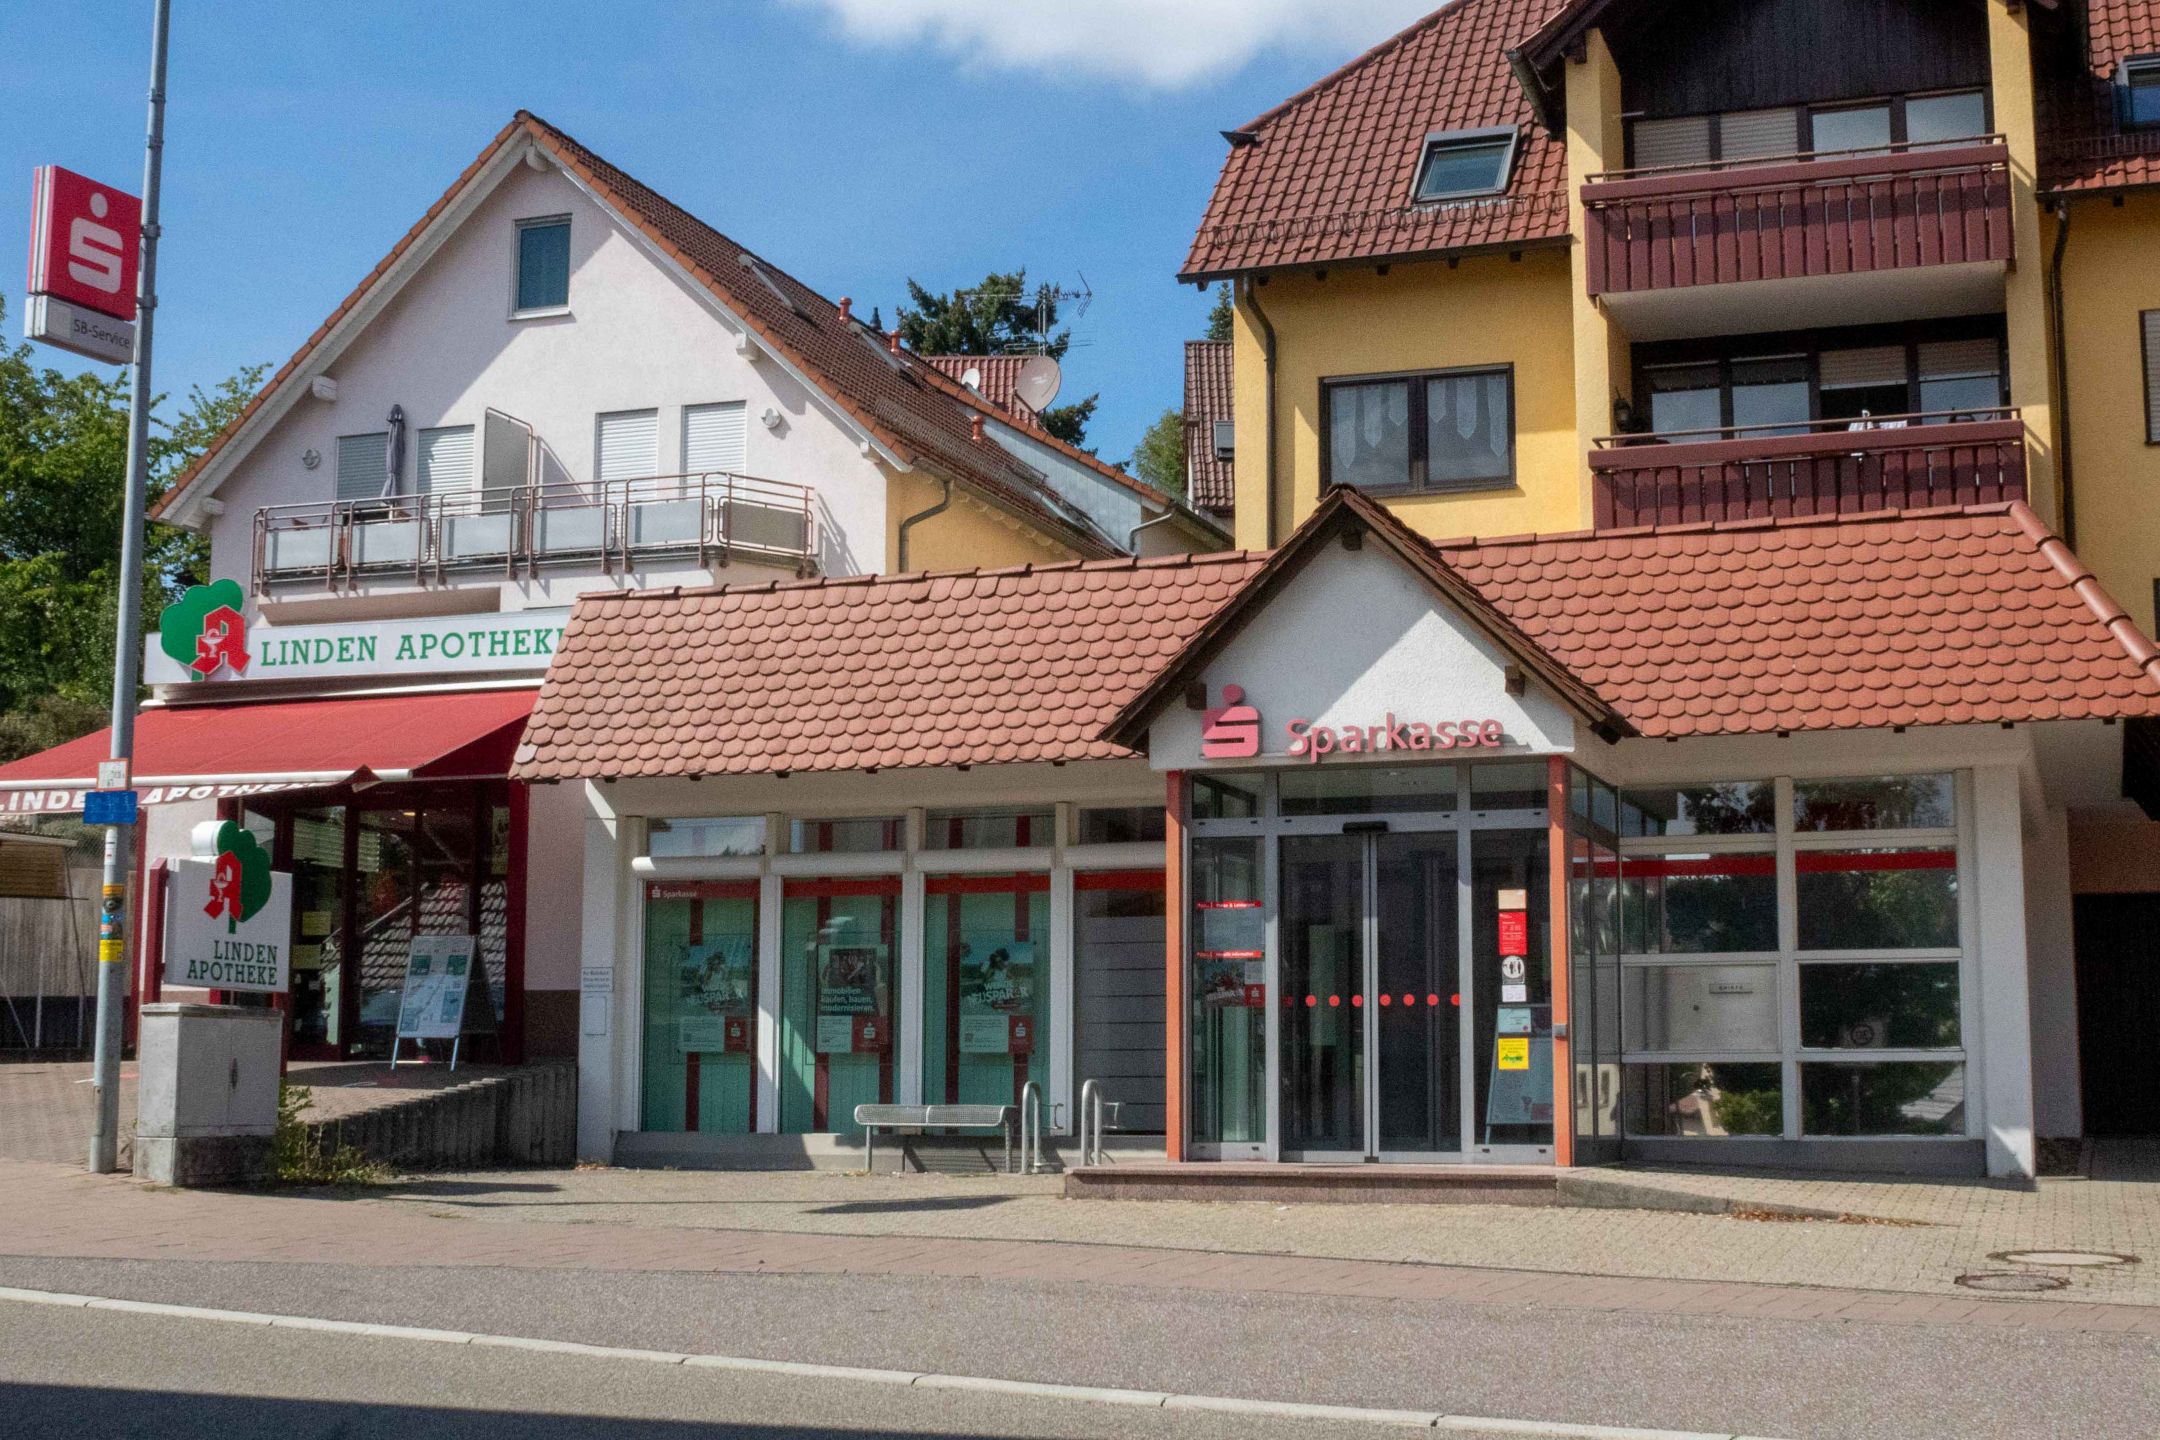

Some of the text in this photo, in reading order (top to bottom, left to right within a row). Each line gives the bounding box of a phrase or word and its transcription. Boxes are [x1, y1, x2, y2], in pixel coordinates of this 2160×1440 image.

[74, 319, 130, 349] SB-Service
[260, 627, 566, 667] LINDEN APOTHEK
[1285, 711, 1505, 764] Sparkasse
[0, 790, 97, 812] INDE
[662, 889, 698, 900] Sparkasse
[213, 939, 279, 965] LINDEN
[186, 959, 278, 986] APOTHEKE
